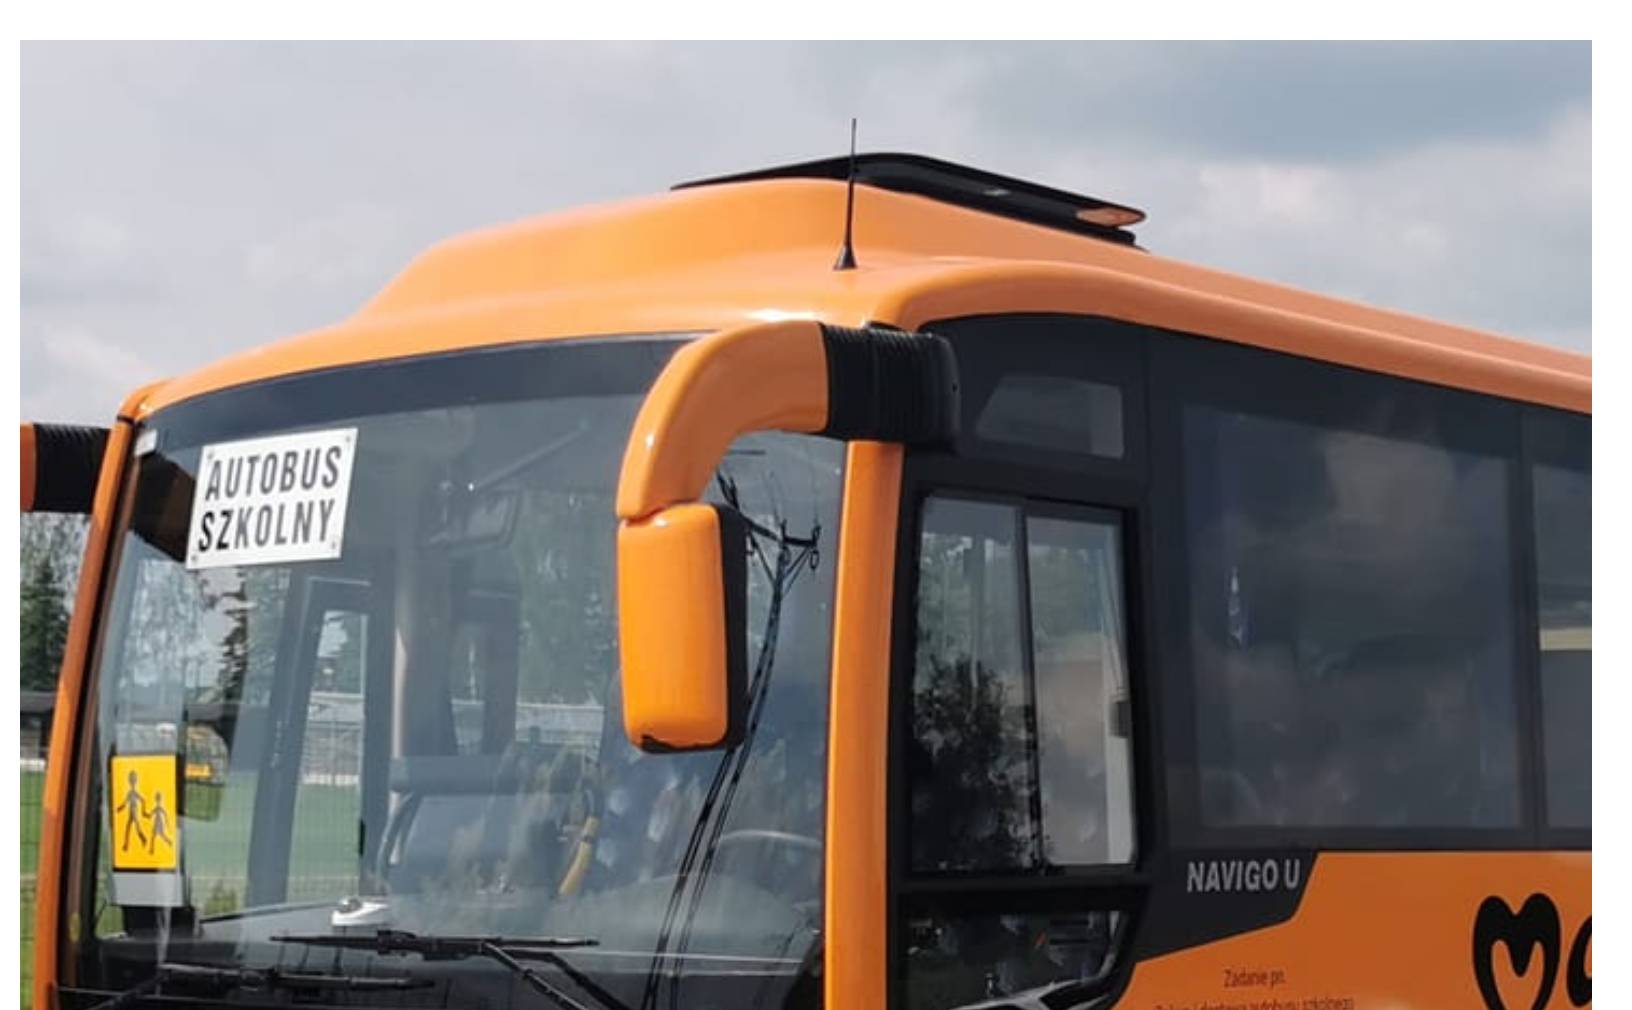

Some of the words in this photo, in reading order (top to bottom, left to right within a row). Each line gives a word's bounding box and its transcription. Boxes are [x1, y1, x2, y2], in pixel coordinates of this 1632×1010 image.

[205, 446, 342, 501] AUTOBUS
[198, 498, 335, 552] SZKOLNY
[1187, 859, 1278, 892] NAVIGO
[1284, 859, 1300, 890] U
